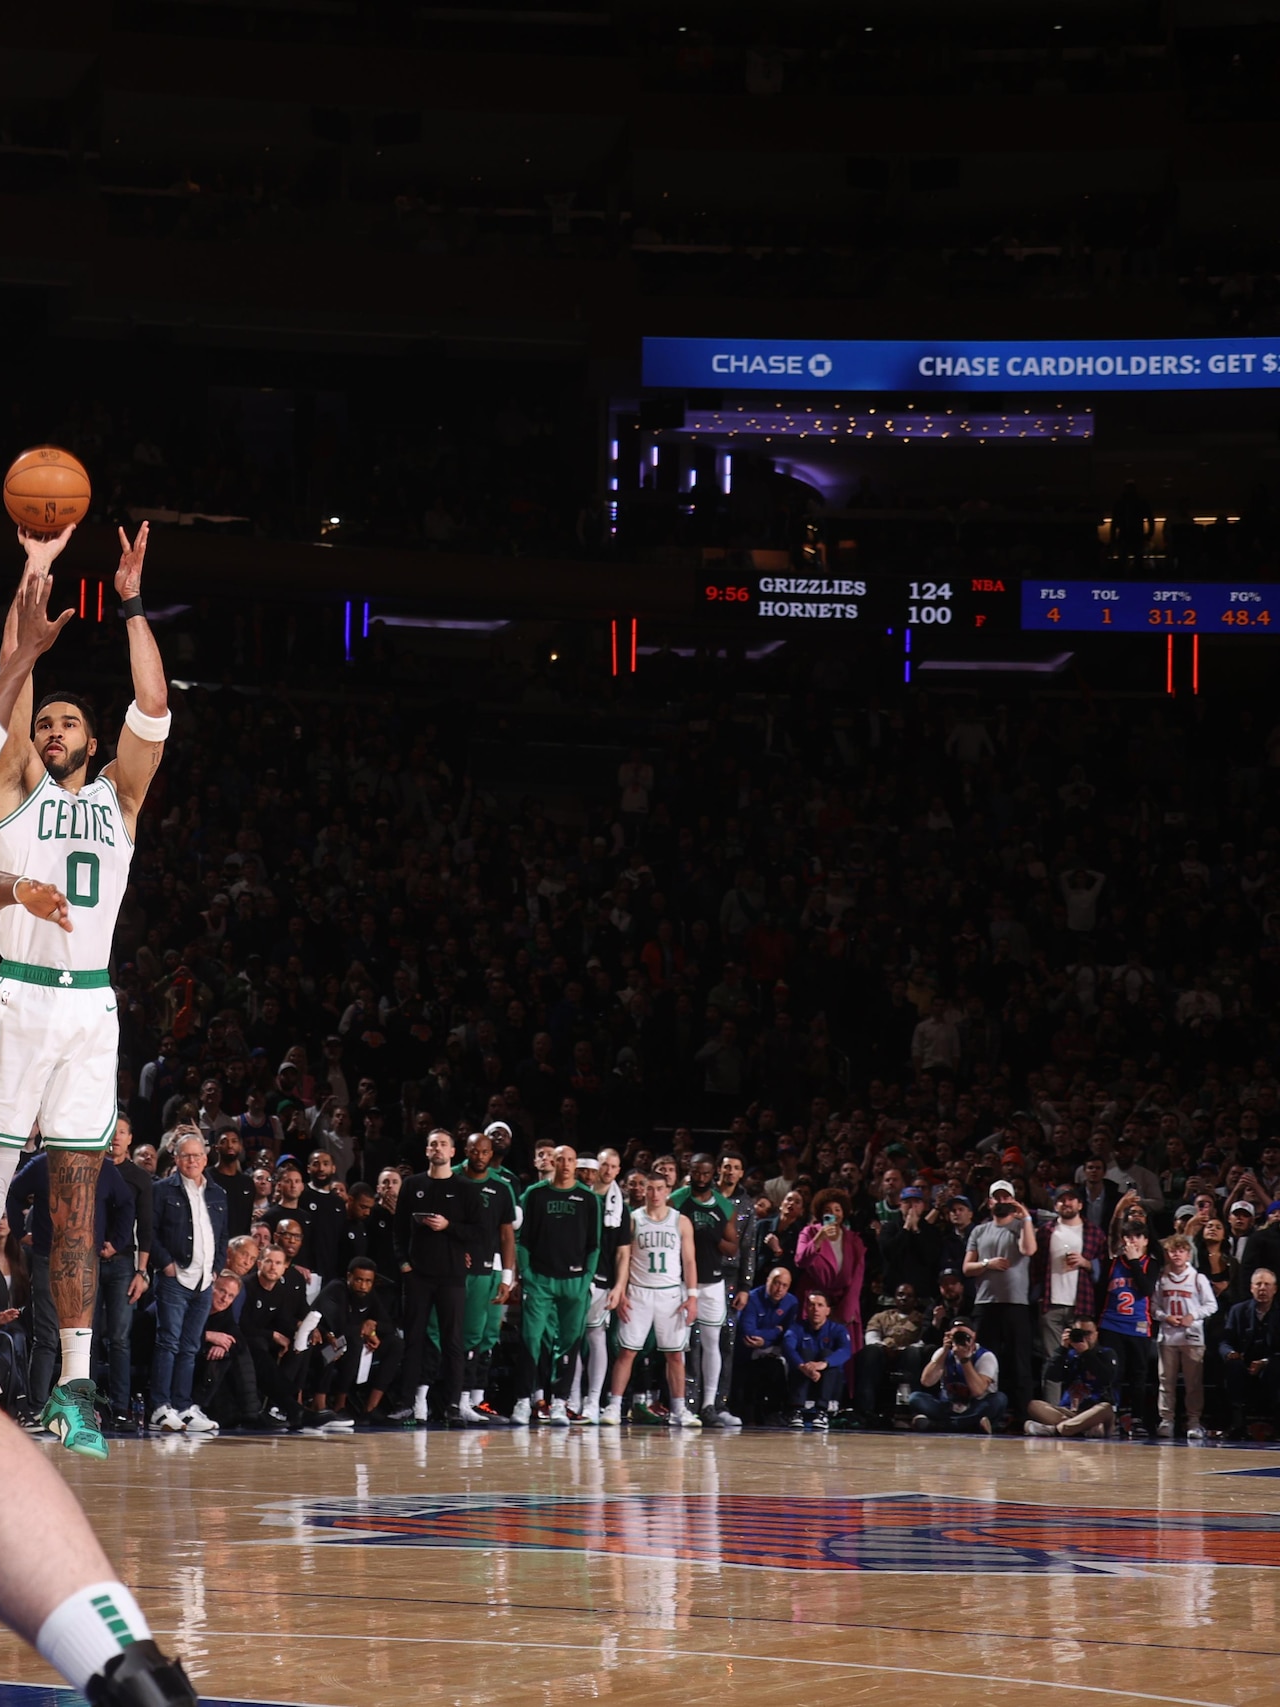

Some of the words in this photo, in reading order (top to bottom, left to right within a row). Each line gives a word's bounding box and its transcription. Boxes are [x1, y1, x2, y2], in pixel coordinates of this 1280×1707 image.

[712, 354, 804, 375] CHASE
[918, 356, 1000, 377] CHASE
[1006, 355, 1201, 376] CARDHOLDERS:
[1208, 354, 1257, 374] GET
[705, 585, 750, 602] 9:56
[758, 577, 867, 597] GRIZZLIES
[908, 582, 953, 601] 124
[971, 579, 1005, 592] NBA
[1040, 589, 1067, 600] FLS
[1091, 590, 1120, 601] TOL
[1152, 591, 1193, 603] 3PT%
[1229, 591, 1262, 603] FG%
[758, 601, 859, 620] HORNETS
[907, 606, 952, 625] 100
[975, 615, 987, 627] F
[1047, 607, 1061, 623] 4
[1101, 608, 1113, 624] 1
[1148, 609, 1197, 626] 31.2
[1221, 610, 1271, 626] 48.4
[38, 799, 115, 847] CELTICS
[66, 851, 100, 908] 0
[638, 1231, 676, 1249] CELTICS
[648, 1252, 667, 1273] 11
[1117, 1292, 1135, 1315] 2
[1171, 1301, 1182, 1315] 11
